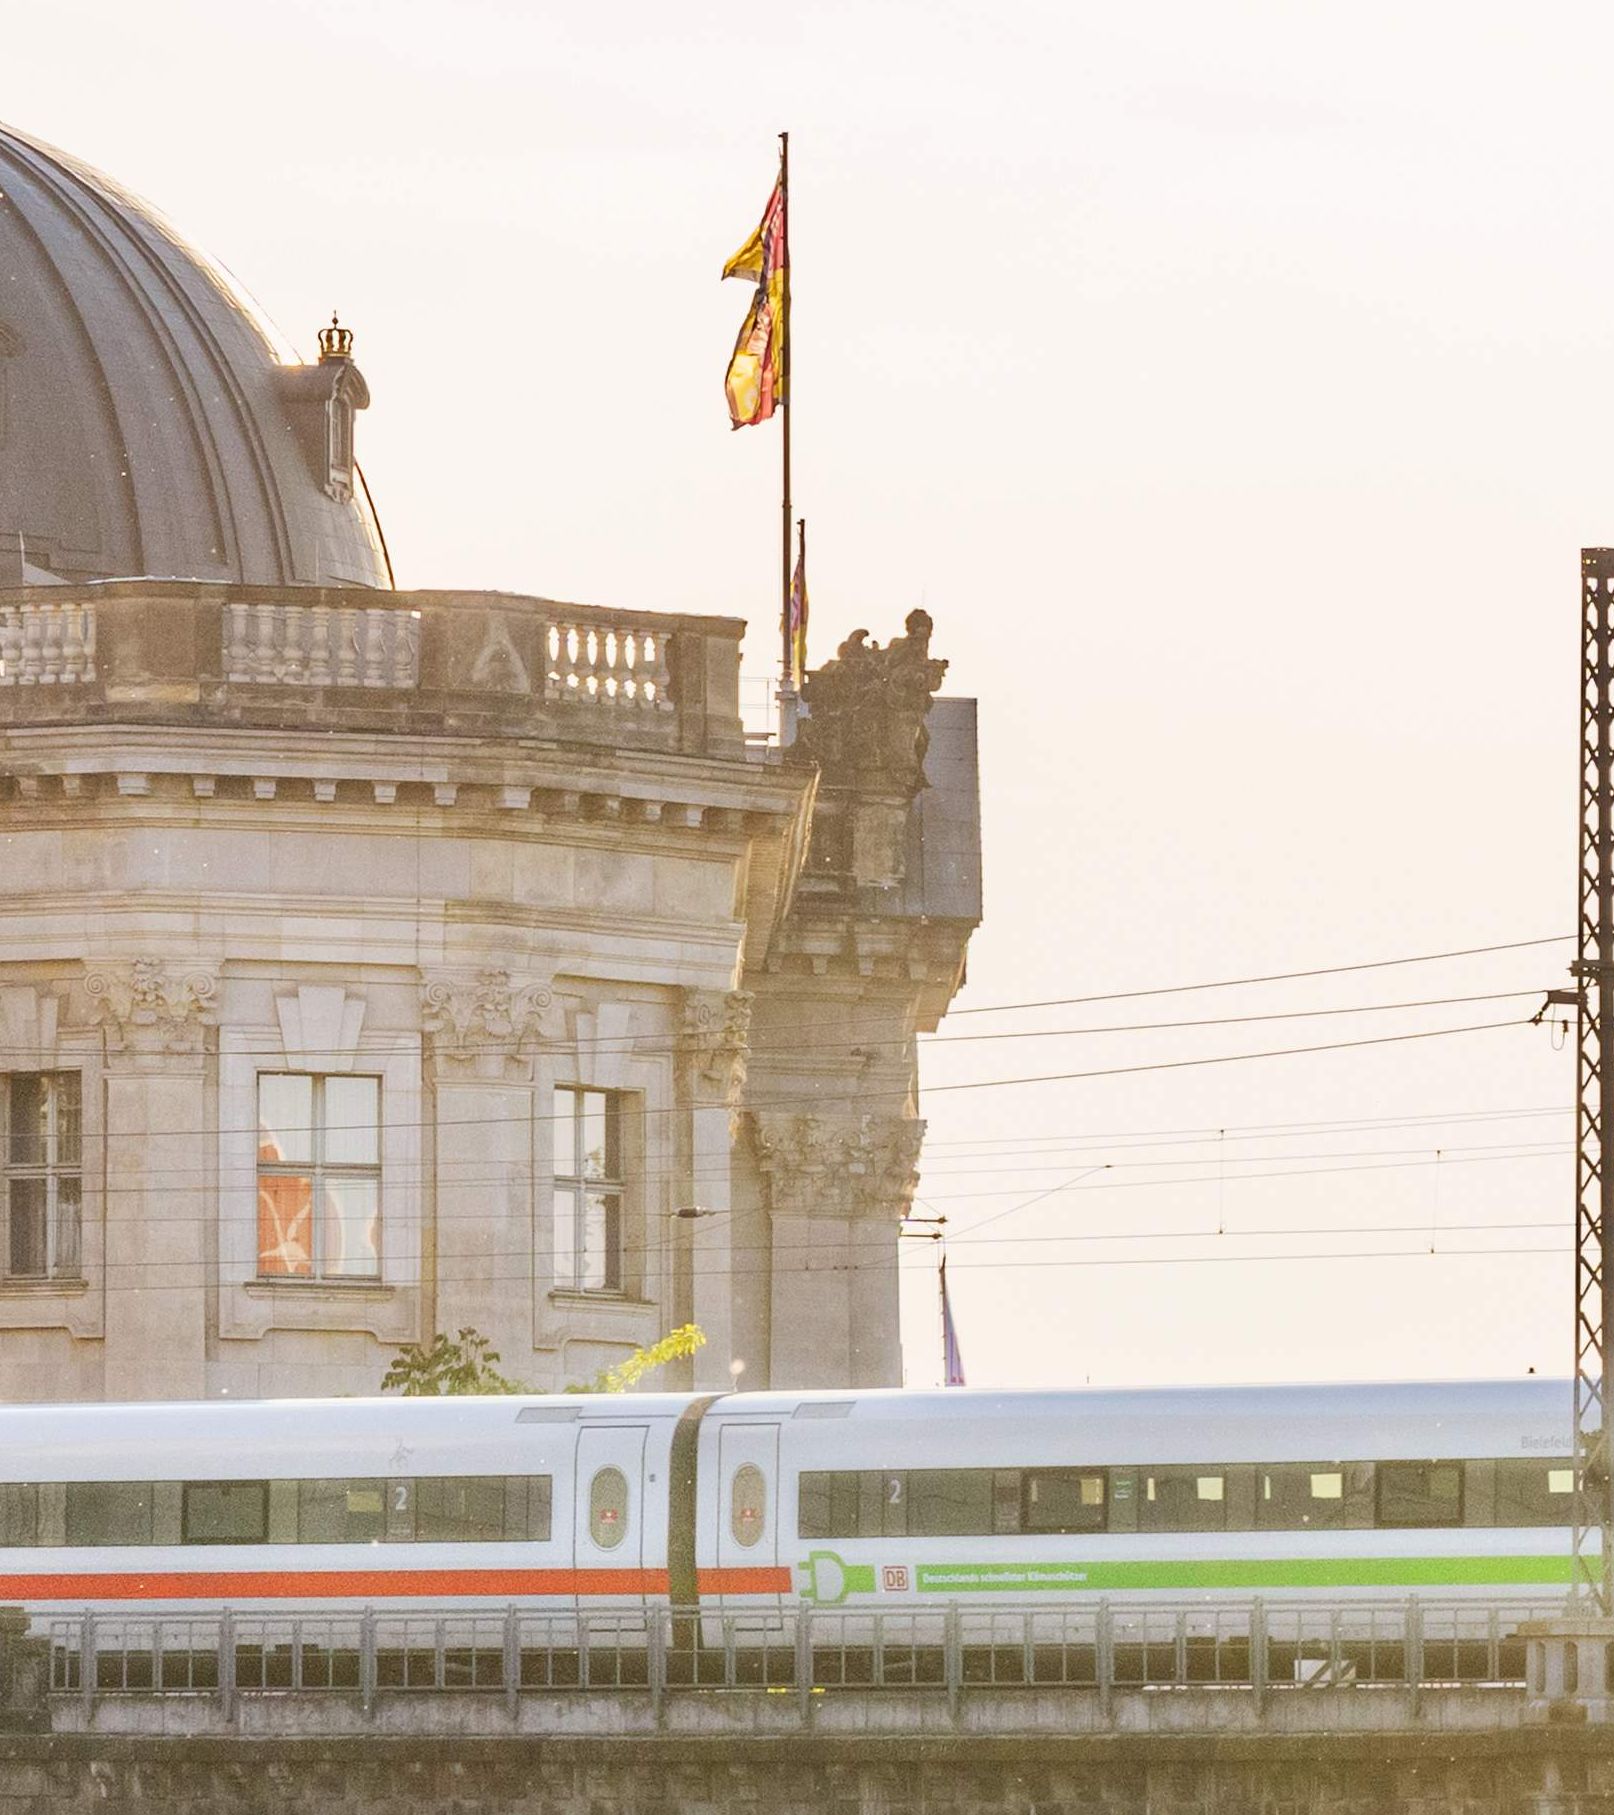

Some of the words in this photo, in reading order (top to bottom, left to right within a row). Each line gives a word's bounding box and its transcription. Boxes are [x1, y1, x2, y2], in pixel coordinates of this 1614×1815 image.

[395, 1486, 407, 1511] 2
[889, 1479, 900, 1504] 2
[885, 1569, 907, 1589] DB
